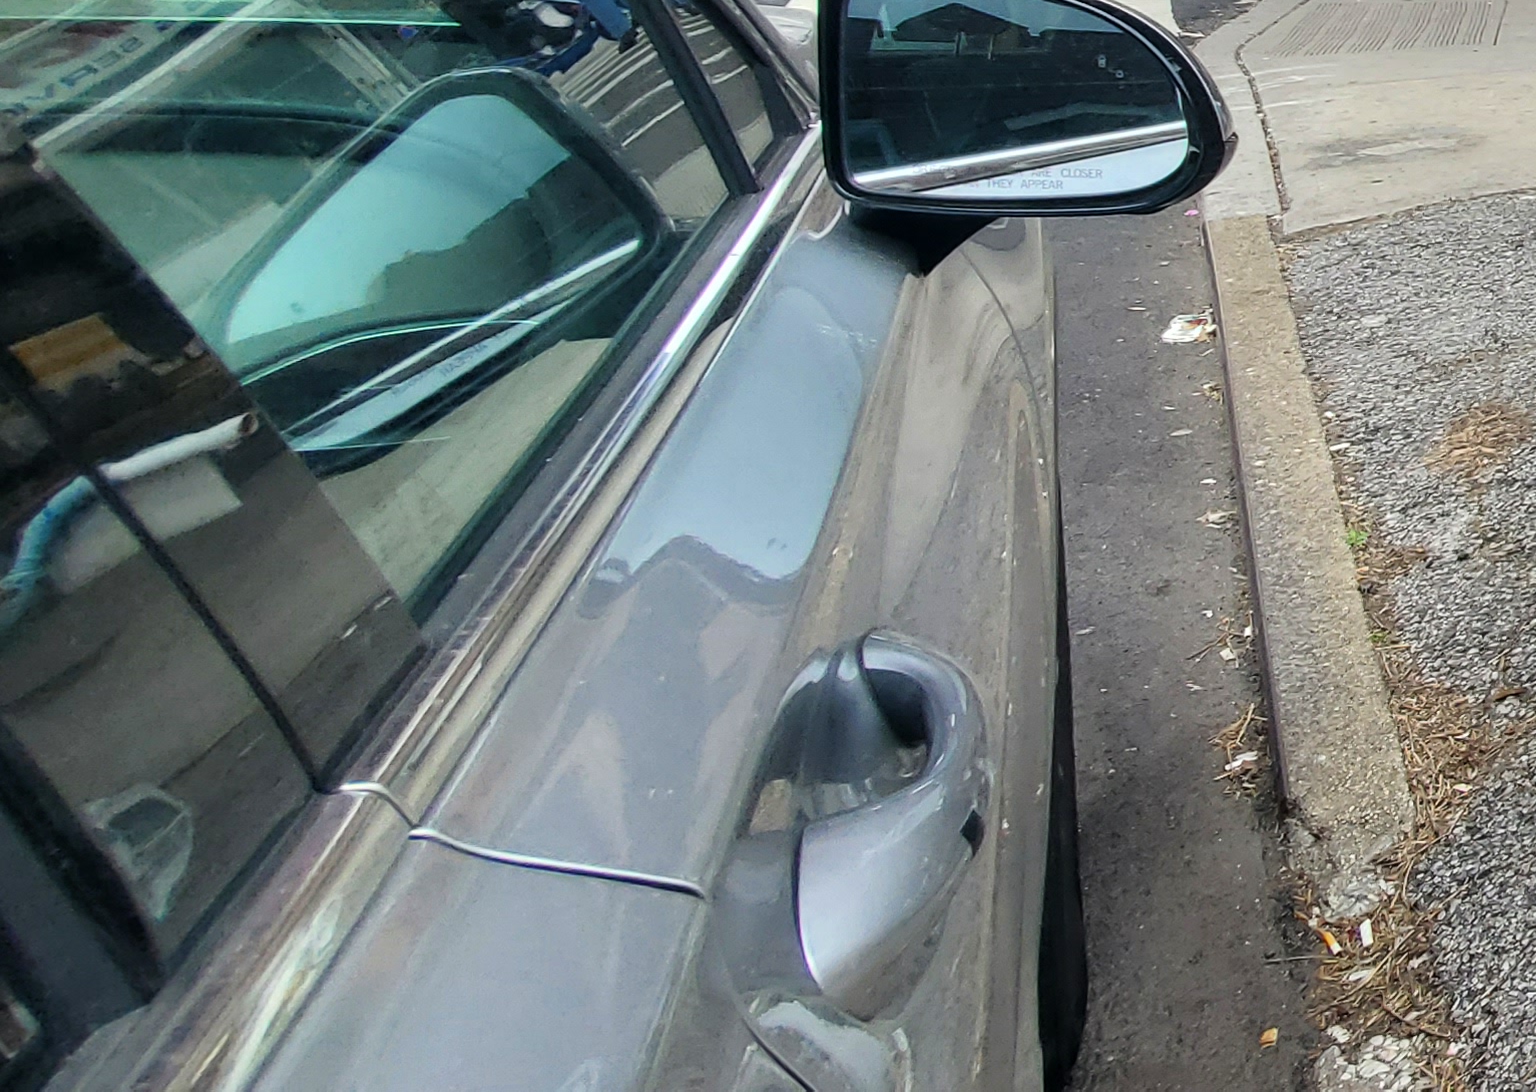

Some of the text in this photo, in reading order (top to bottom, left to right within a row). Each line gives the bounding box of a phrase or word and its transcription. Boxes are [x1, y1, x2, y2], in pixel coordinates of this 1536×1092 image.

[1061, 168, 1103, 179] CLOSER
[986, 178, 1013, 189] THEY
[1020, 179, 1064, 191] APPEAR
